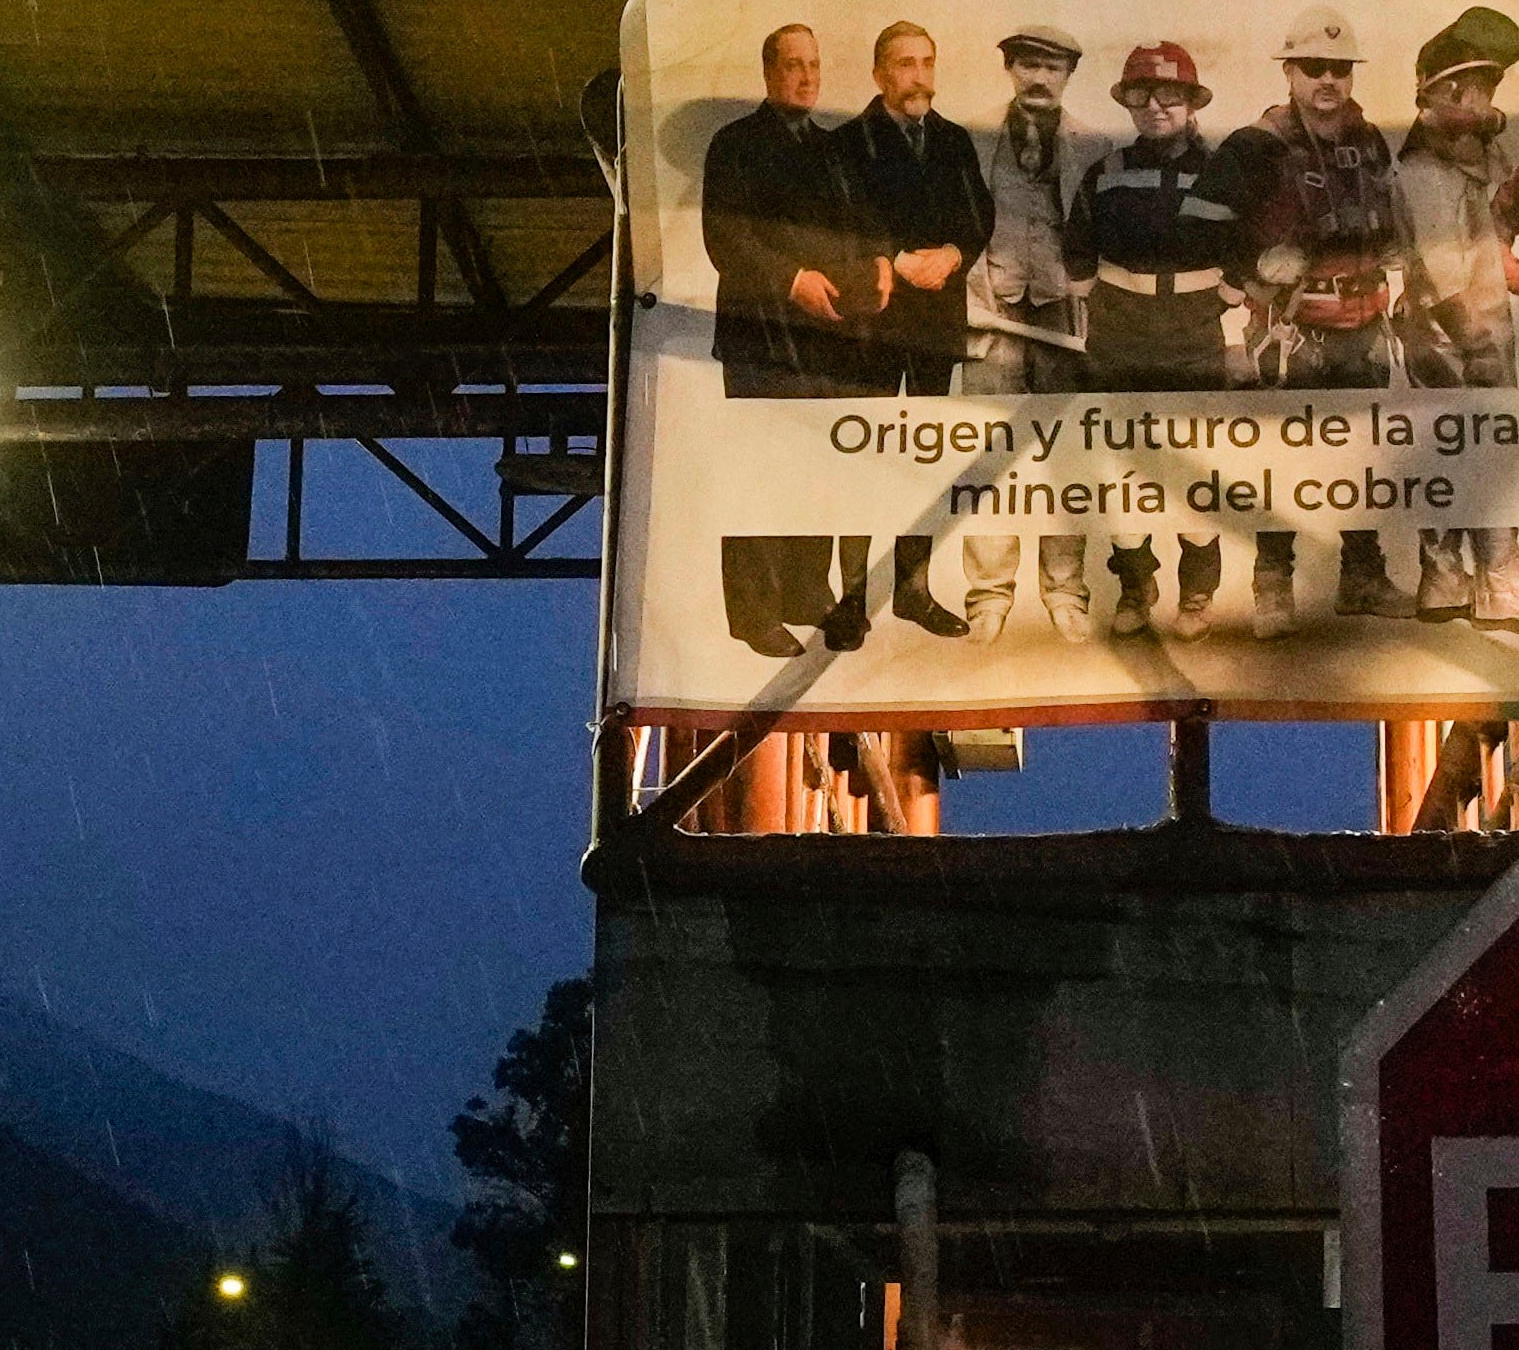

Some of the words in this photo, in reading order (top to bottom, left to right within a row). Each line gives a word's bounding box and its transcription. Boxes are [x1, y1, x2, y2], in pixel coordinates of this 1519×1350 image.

[829, 412, 1016, 463] Origen
[1029, 421, 1067, 462] y
[1079, 404, 1261, 453] futuro
[1280, 404, 1352, 449] de
[1370, 402, 1414, 447] la
[949, 469, 1165, 515] minería
[1186, 468, 1272, 512] del
[1293, 465, 1455, 512] cobre
